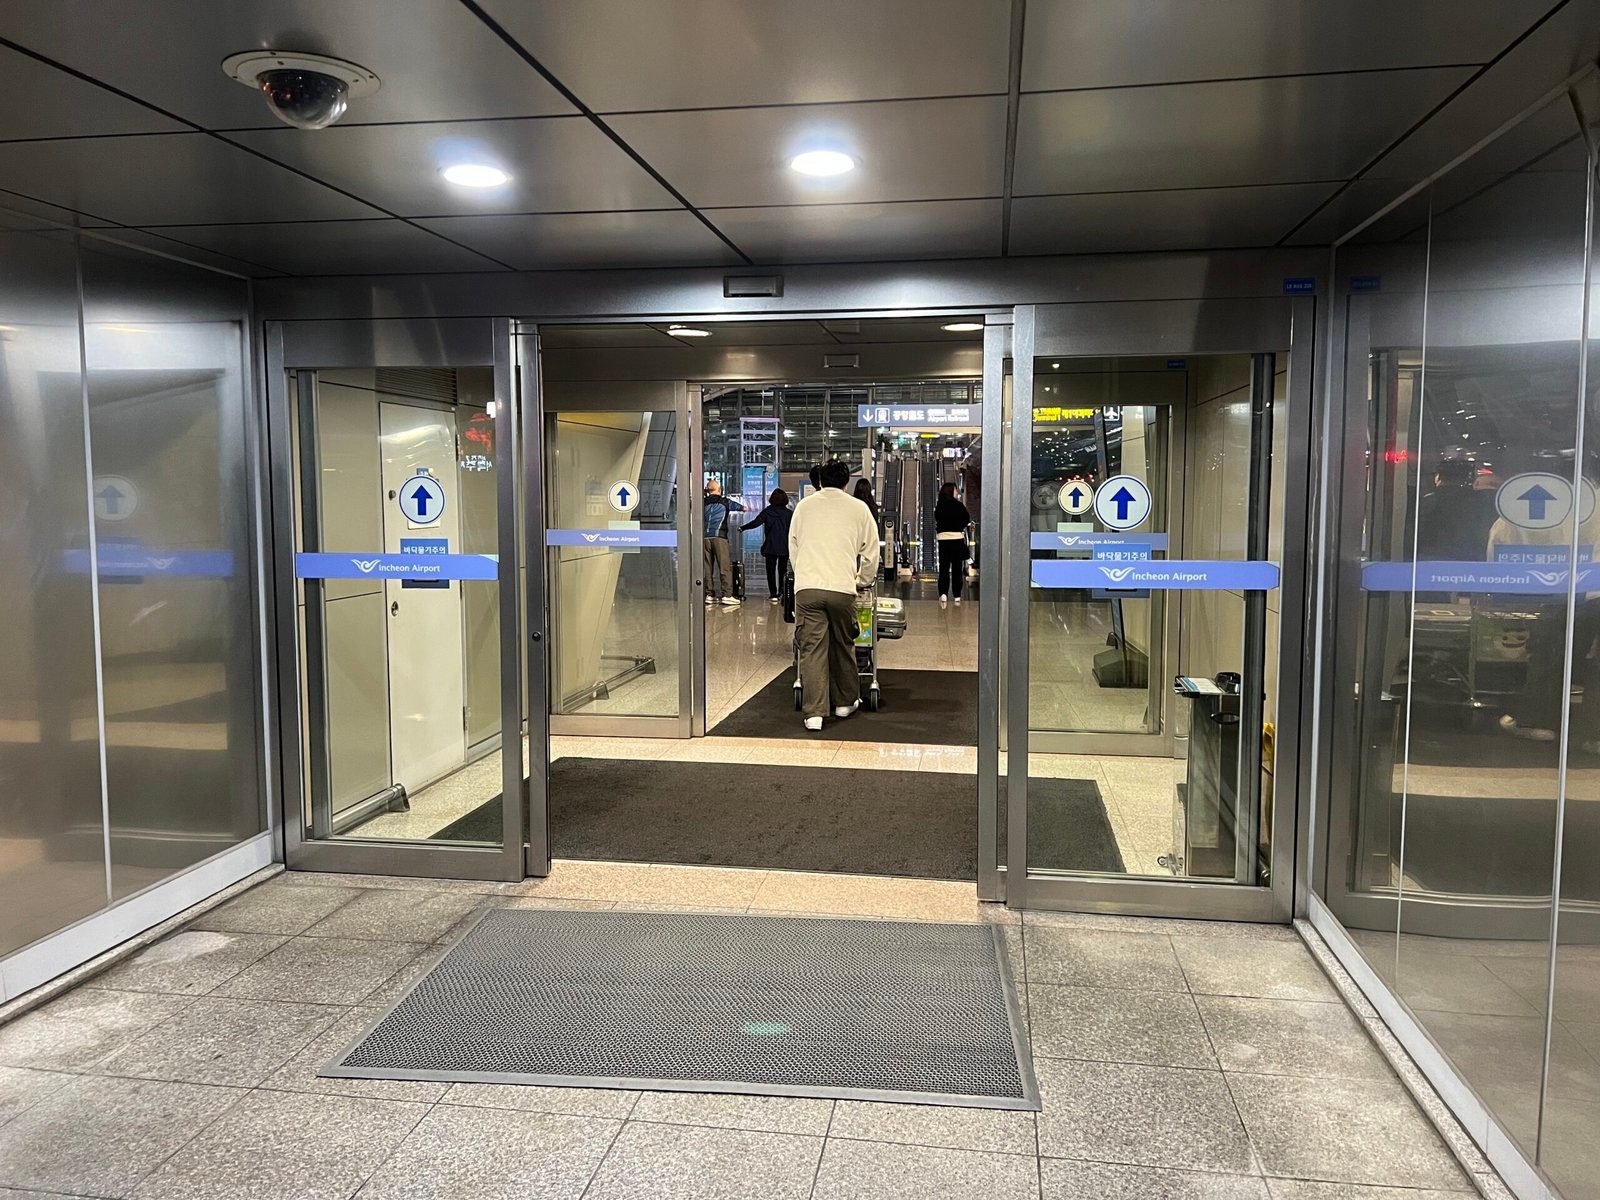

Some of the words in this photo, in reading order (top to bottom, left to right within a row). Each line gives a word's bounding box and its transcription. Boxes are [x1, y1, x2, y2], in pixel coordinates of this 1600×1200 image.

[403, 546, 446, 554] 바닥물기주의
[1097, 551, 1148, 561] 바닥물기주의
[378, 563, 410, 572] Incheon
[411, 564, 441, 573] Airport
[1132, 572, 1169, 581] Incheon
[1172, 573, 1207, 582] Airport
